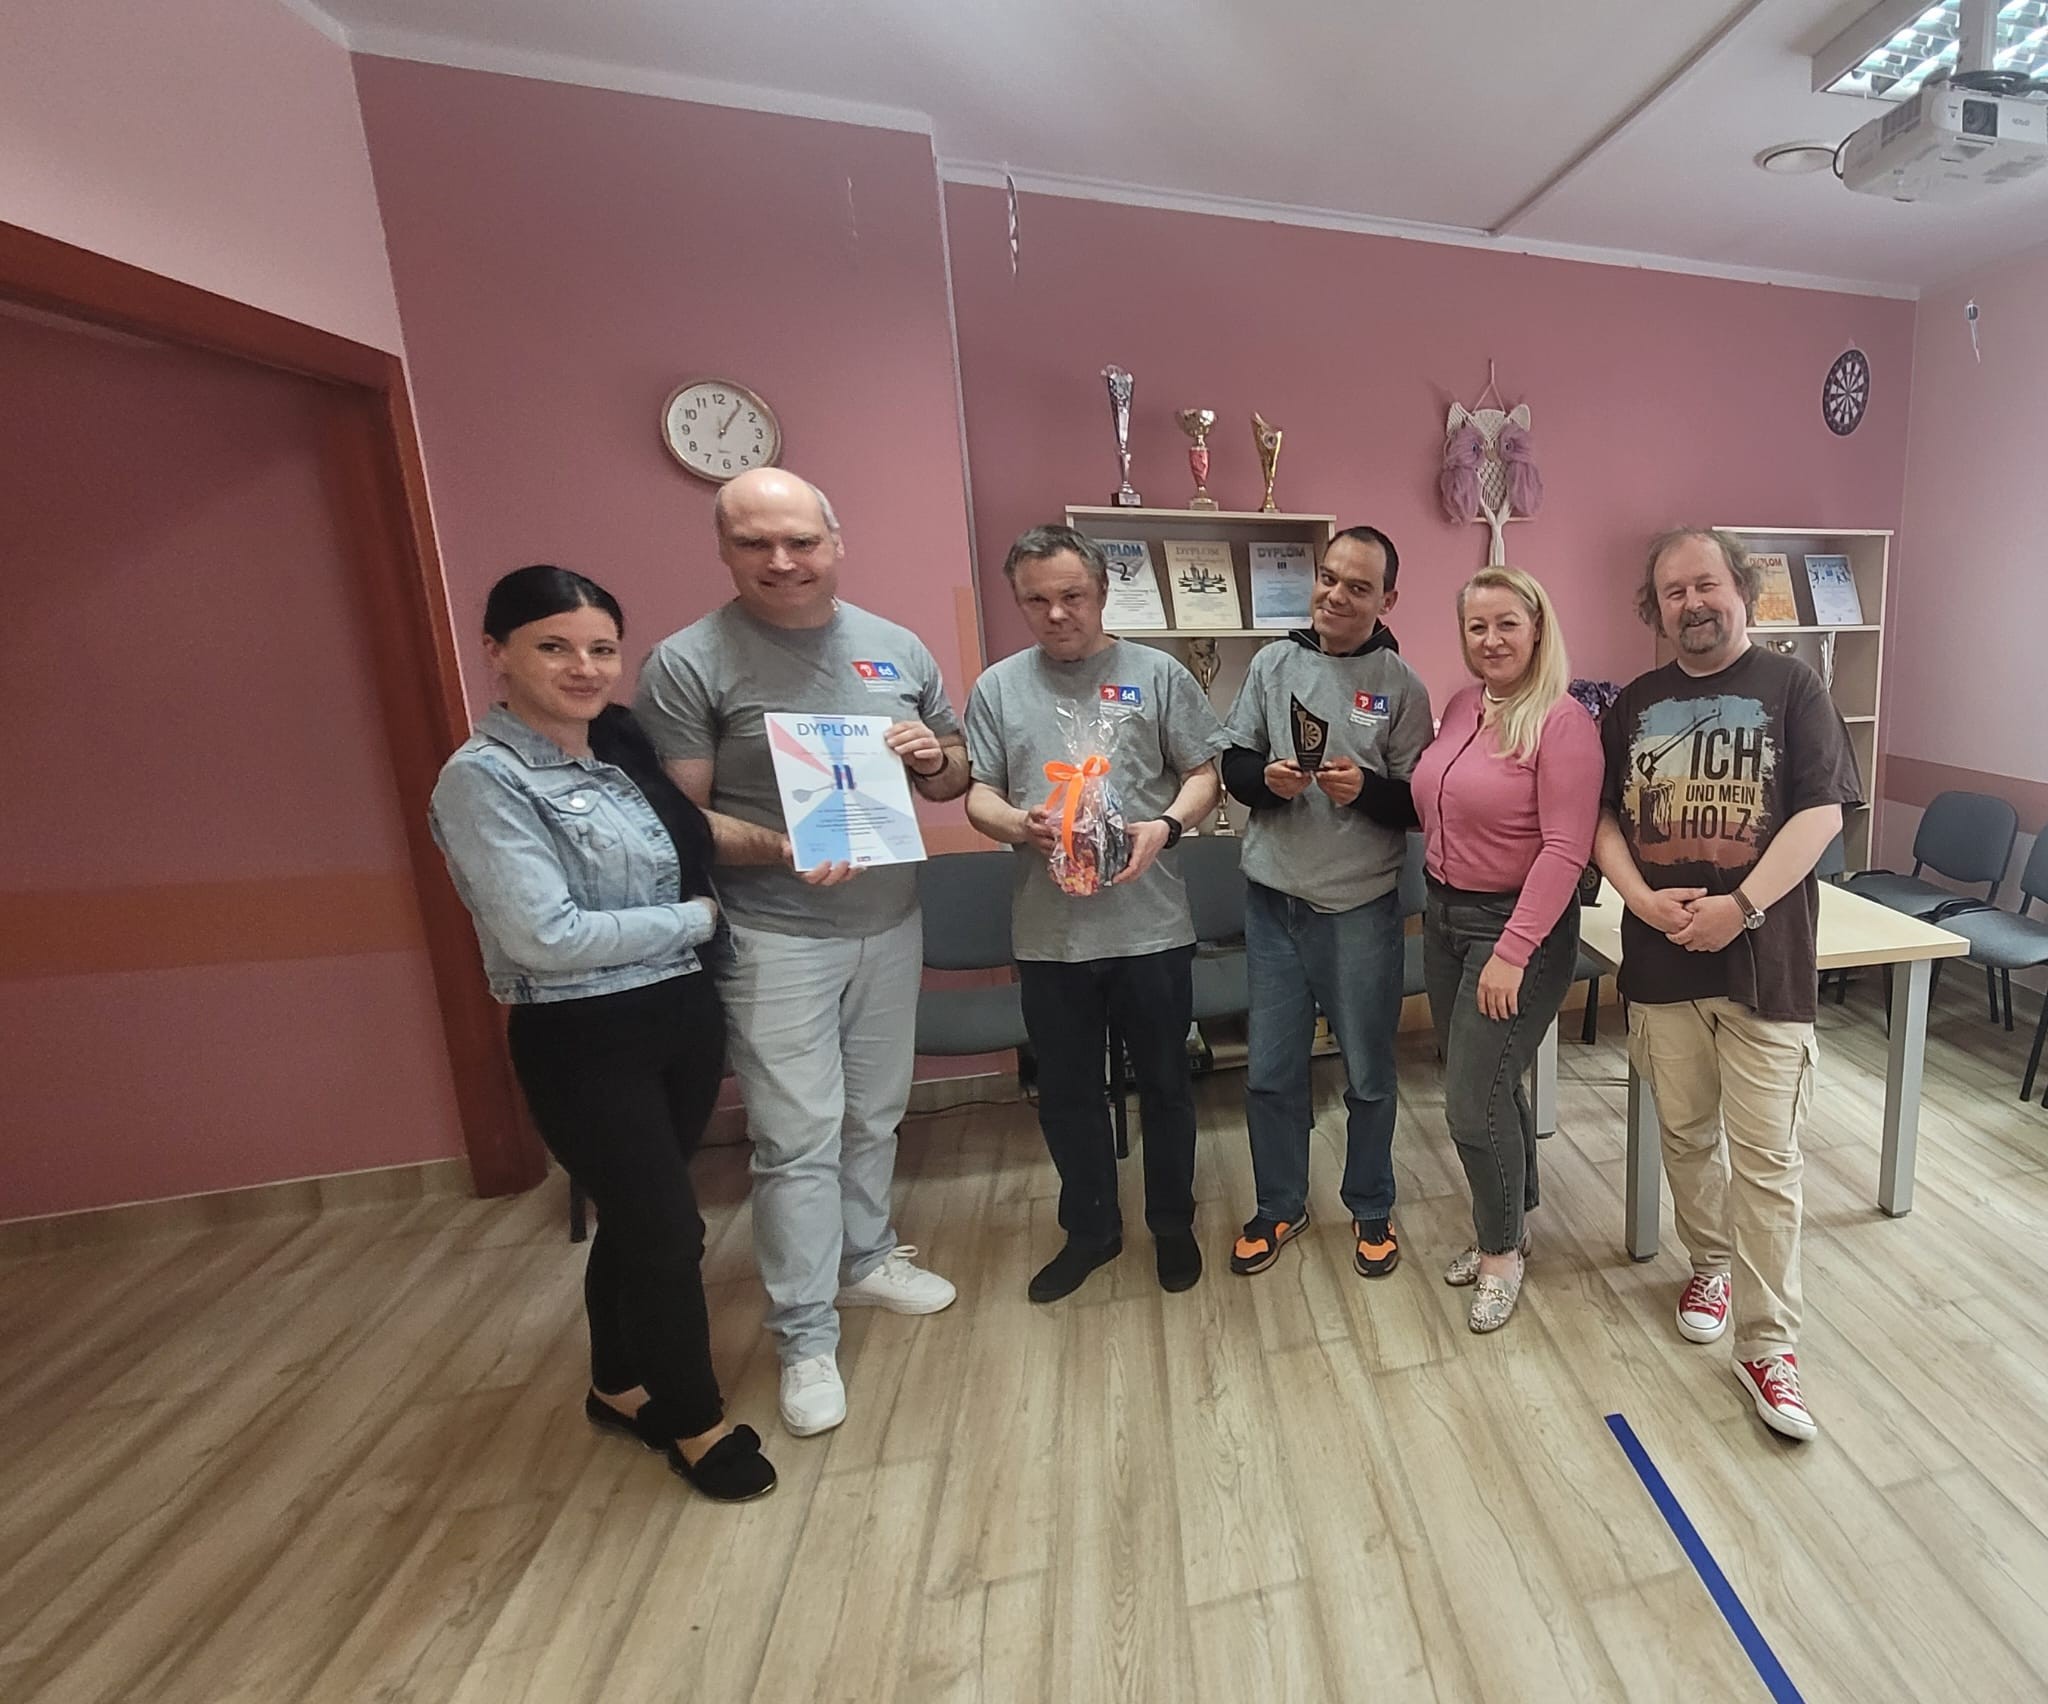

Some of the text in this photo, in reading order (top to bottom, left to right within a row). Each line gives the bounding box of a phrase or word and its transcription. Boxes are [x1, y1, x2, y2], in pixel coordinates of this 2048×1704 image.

[696, 398, 707, 408] 11
[712, 394, 726, 405] 12
[685, 409, 697, 420] 10
[748, 412, 756, 423] 2
[681, 424, 690, 435] 9
[755, 428, 763, 439] 3
[689, 441, 698, 452] 8
[752, 444, 760, 454] 4
[704, 453, 712, 464] 7
[722, 458, 732, 469] 6
[740, 455, 749, 466] 5
[1101, 543, 1143, 557] YPLOM
[1116, 561, 1131, 581] 2
[796, 722, 869, 737] DYPLOM
[1689, 727, 1764, 783] ICH
[1686, 784, 1756, 805] UND MEIN
[1681, 805, 1752, 842] HOLZ
